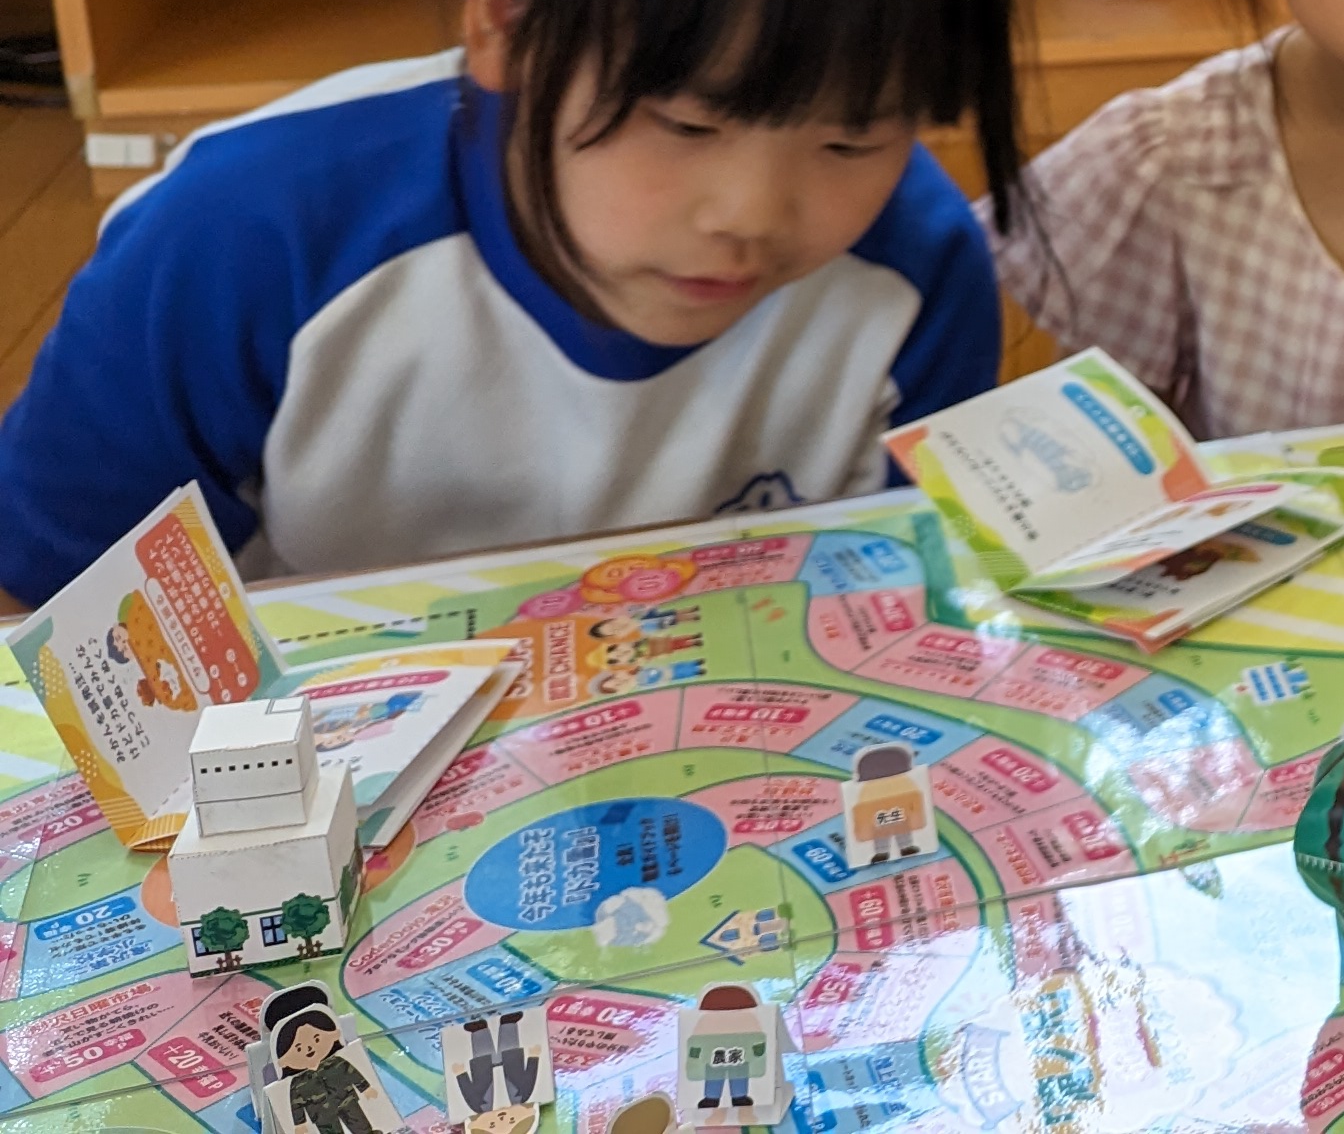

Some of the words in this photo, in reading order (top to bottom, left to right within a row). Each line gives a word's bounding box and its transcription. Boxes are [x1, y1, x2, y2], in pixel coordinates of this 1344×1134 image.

[549, 624, 569, 673] CHANCE
[876, 808, 904, 826] 先生
[858, 890, 881, 916] +60
[348, 913, 426, 971] CoderDojo
[38, 1044, 104, 1076] +50
[161, 1038, 202, 1073] +20
[712, 1047, 744, 1066] 農家
